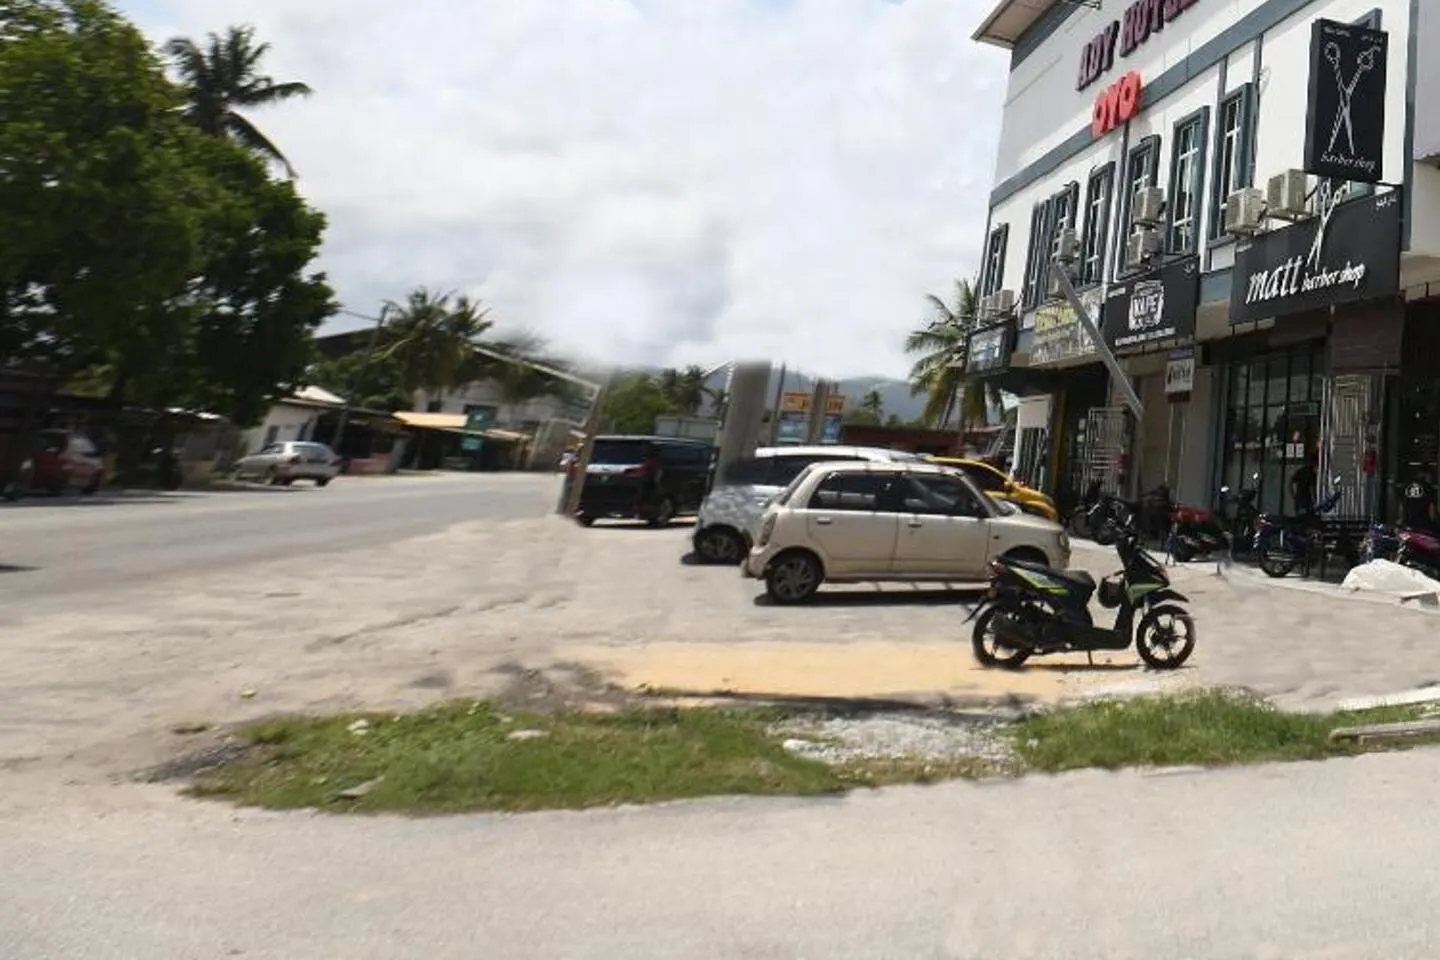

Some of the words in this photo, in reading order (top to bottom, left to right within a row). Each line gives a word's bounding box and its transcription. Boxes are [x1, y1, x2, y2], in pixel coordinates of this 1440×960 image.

[1092, 70, 1141, 140] OYO
[1302, 266, 1340, 292] barber
[1338, 261, 1366, 289] shop
